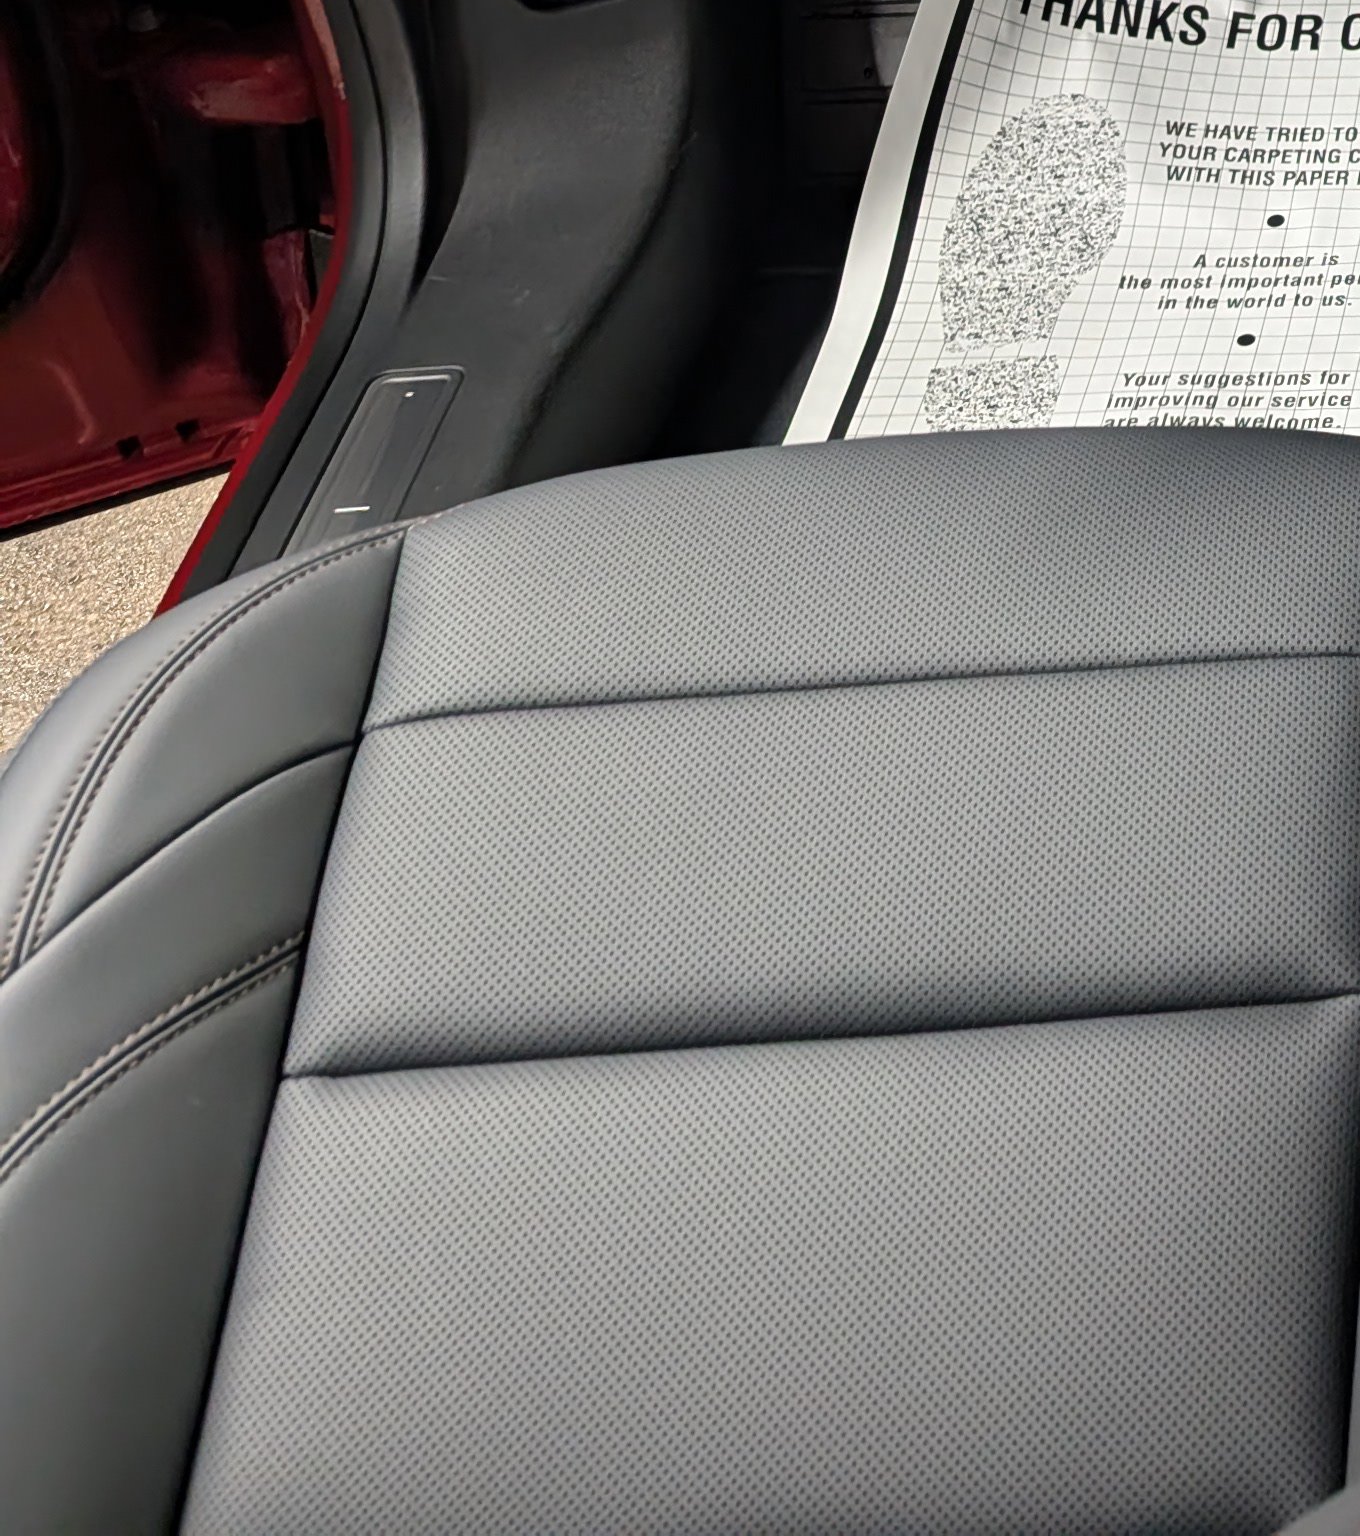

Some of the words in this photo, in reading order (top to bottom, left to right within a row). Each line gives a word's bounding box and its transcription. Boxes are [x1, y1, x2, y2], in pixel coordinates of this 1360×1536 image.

[1225, 11, 1322, 51] FOR
[1166, 120, 1199, 140] WE
[1203, 123, 1258, 142] HAVE
[1267, 125, 1326, 143] TRIED
[1332, 126, 1358, 143] TO
[1160, 142, 1217, 162] YOUR
[1223, 146, 1342, 165] CARPETING
[1166, 165, 1223, 185] WITH
[1228, 169, 1275, 187] THIS
[1282, 169, 1348, 188] PAPER
[1193, 254, 1207, 268] A
[1215, 254, 1314, 268] customer
[1321, 252, 1339, 267] is
[1119, 275, 1152, 290] the
[1160, 275, 1212, 290] most
[1220, 273, 1324, 293] important
[1157, 295, 1176, 310] in
[1186, 295, 1218, 310] the
[1227, 293, 1286, 309] world
[1293, 292, 1314, 307] to
[1321, 293, 1353, 308] us.
[1123, 372, 1170, 387] Your
[1178, 371, 1312, 388] suggestions
[1319, 370, 1350, 385] for
[1107, 394, 1218, 411] improving
[1227, 396, 1264, 408] our
[1271, 393, 1353, 408] service
[1104, 417, 1139, 428] are
